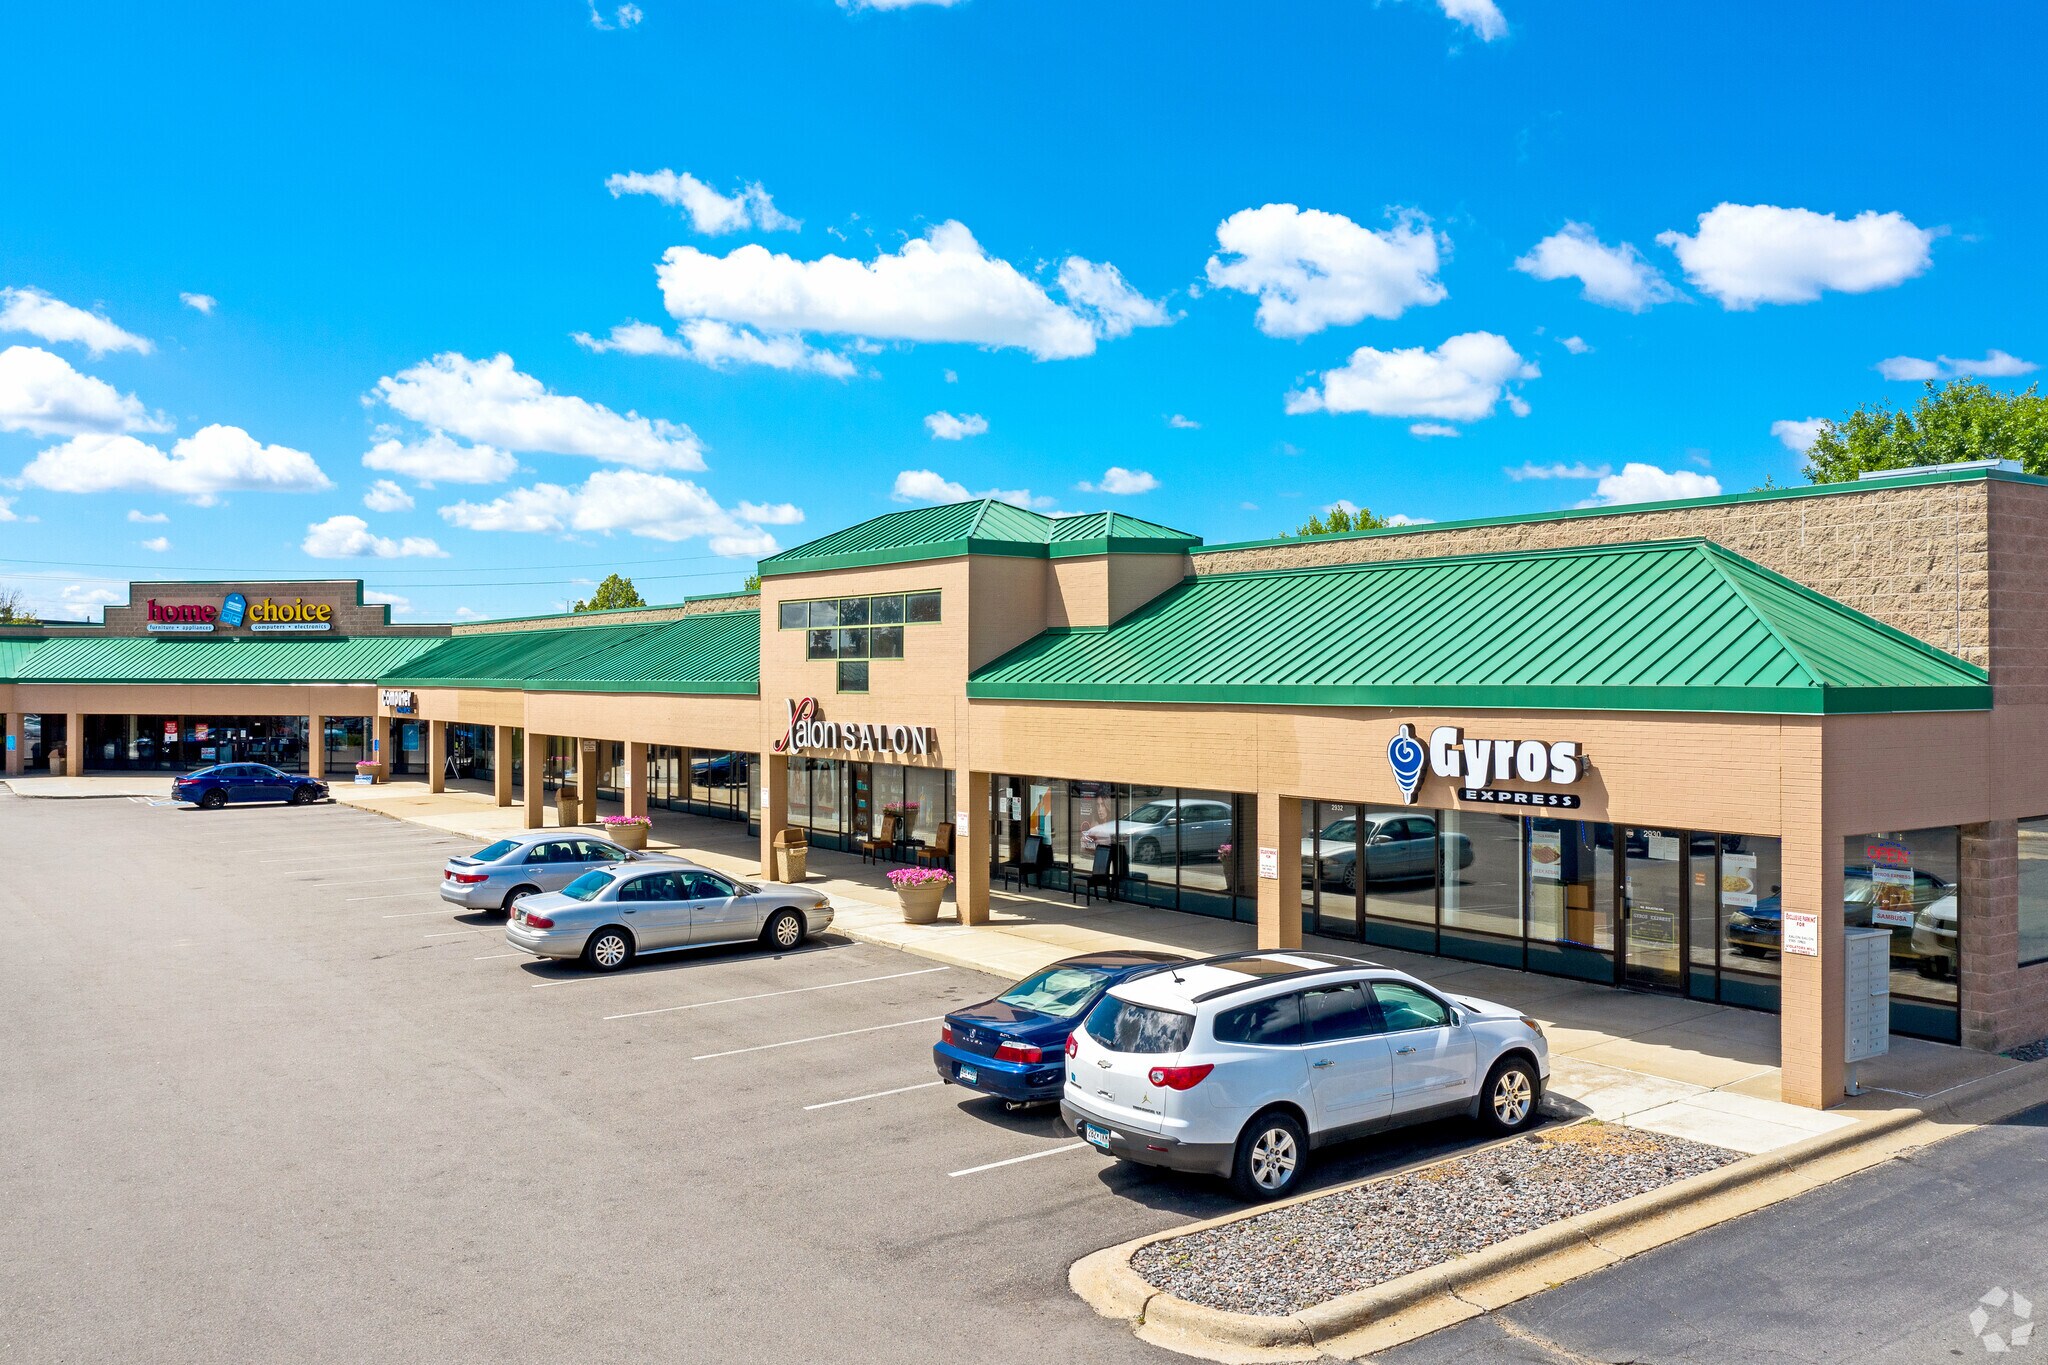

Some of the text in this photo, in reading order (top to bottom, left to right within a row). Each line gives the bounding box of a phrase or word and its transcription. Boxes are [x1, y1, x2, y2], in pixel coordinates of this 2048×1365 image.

[147, 599, 215, 622] home
[249, 598, 332, 622] choice
[773, 697, 927, 756] Xalon SALON
[1430, 726, 1577, 789] Gyros
[1466, 789, 1572, 807] EXPRESS
[1643, 830, 1662, 838] 2930
[1867, 845, 1909, 864] OPEN
[1877, 913, 1907, 922] SAMBUSA
